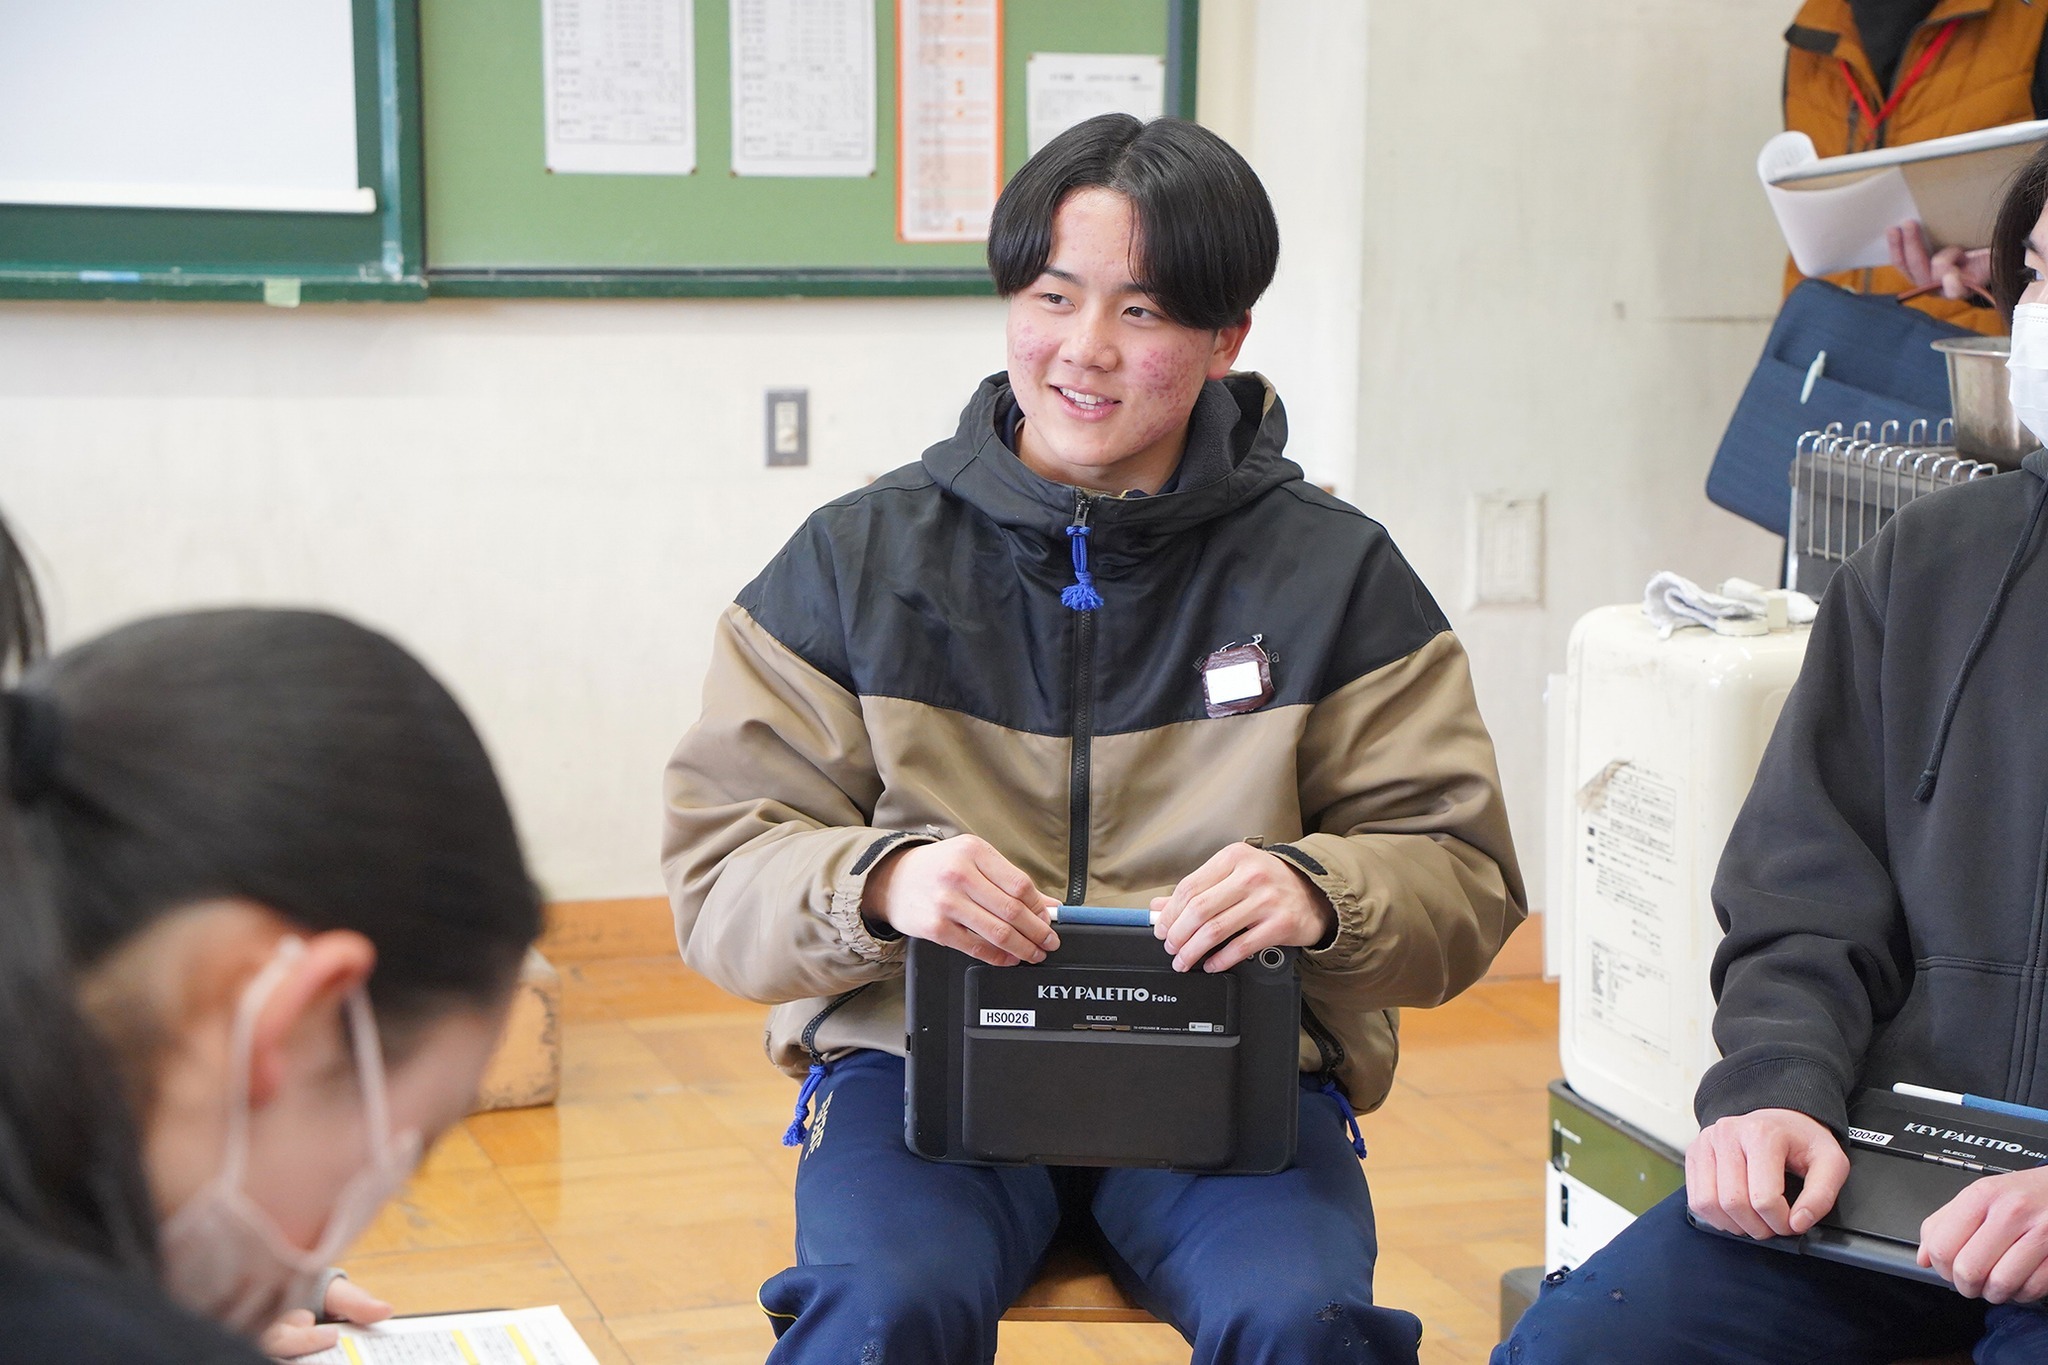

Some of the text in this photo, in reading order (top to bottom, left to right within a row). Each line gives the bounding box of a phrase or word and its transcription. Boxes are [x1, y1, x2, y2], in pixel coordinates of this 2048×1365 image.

[1038, 985, 1178, 1003] KEY PALETTO Folio
[986, 1012, 1030, 1024] HS0026
[1086, 1014, 1118, 1022] ELECOM
[1847, 1128, 1885, 1142] S0049
[1904, 1122, 1944, 1137] KEY
[1942, 1130, 2024, 1153] PALETTO
[1942, 1148, 1976, 1159] ELECOM
